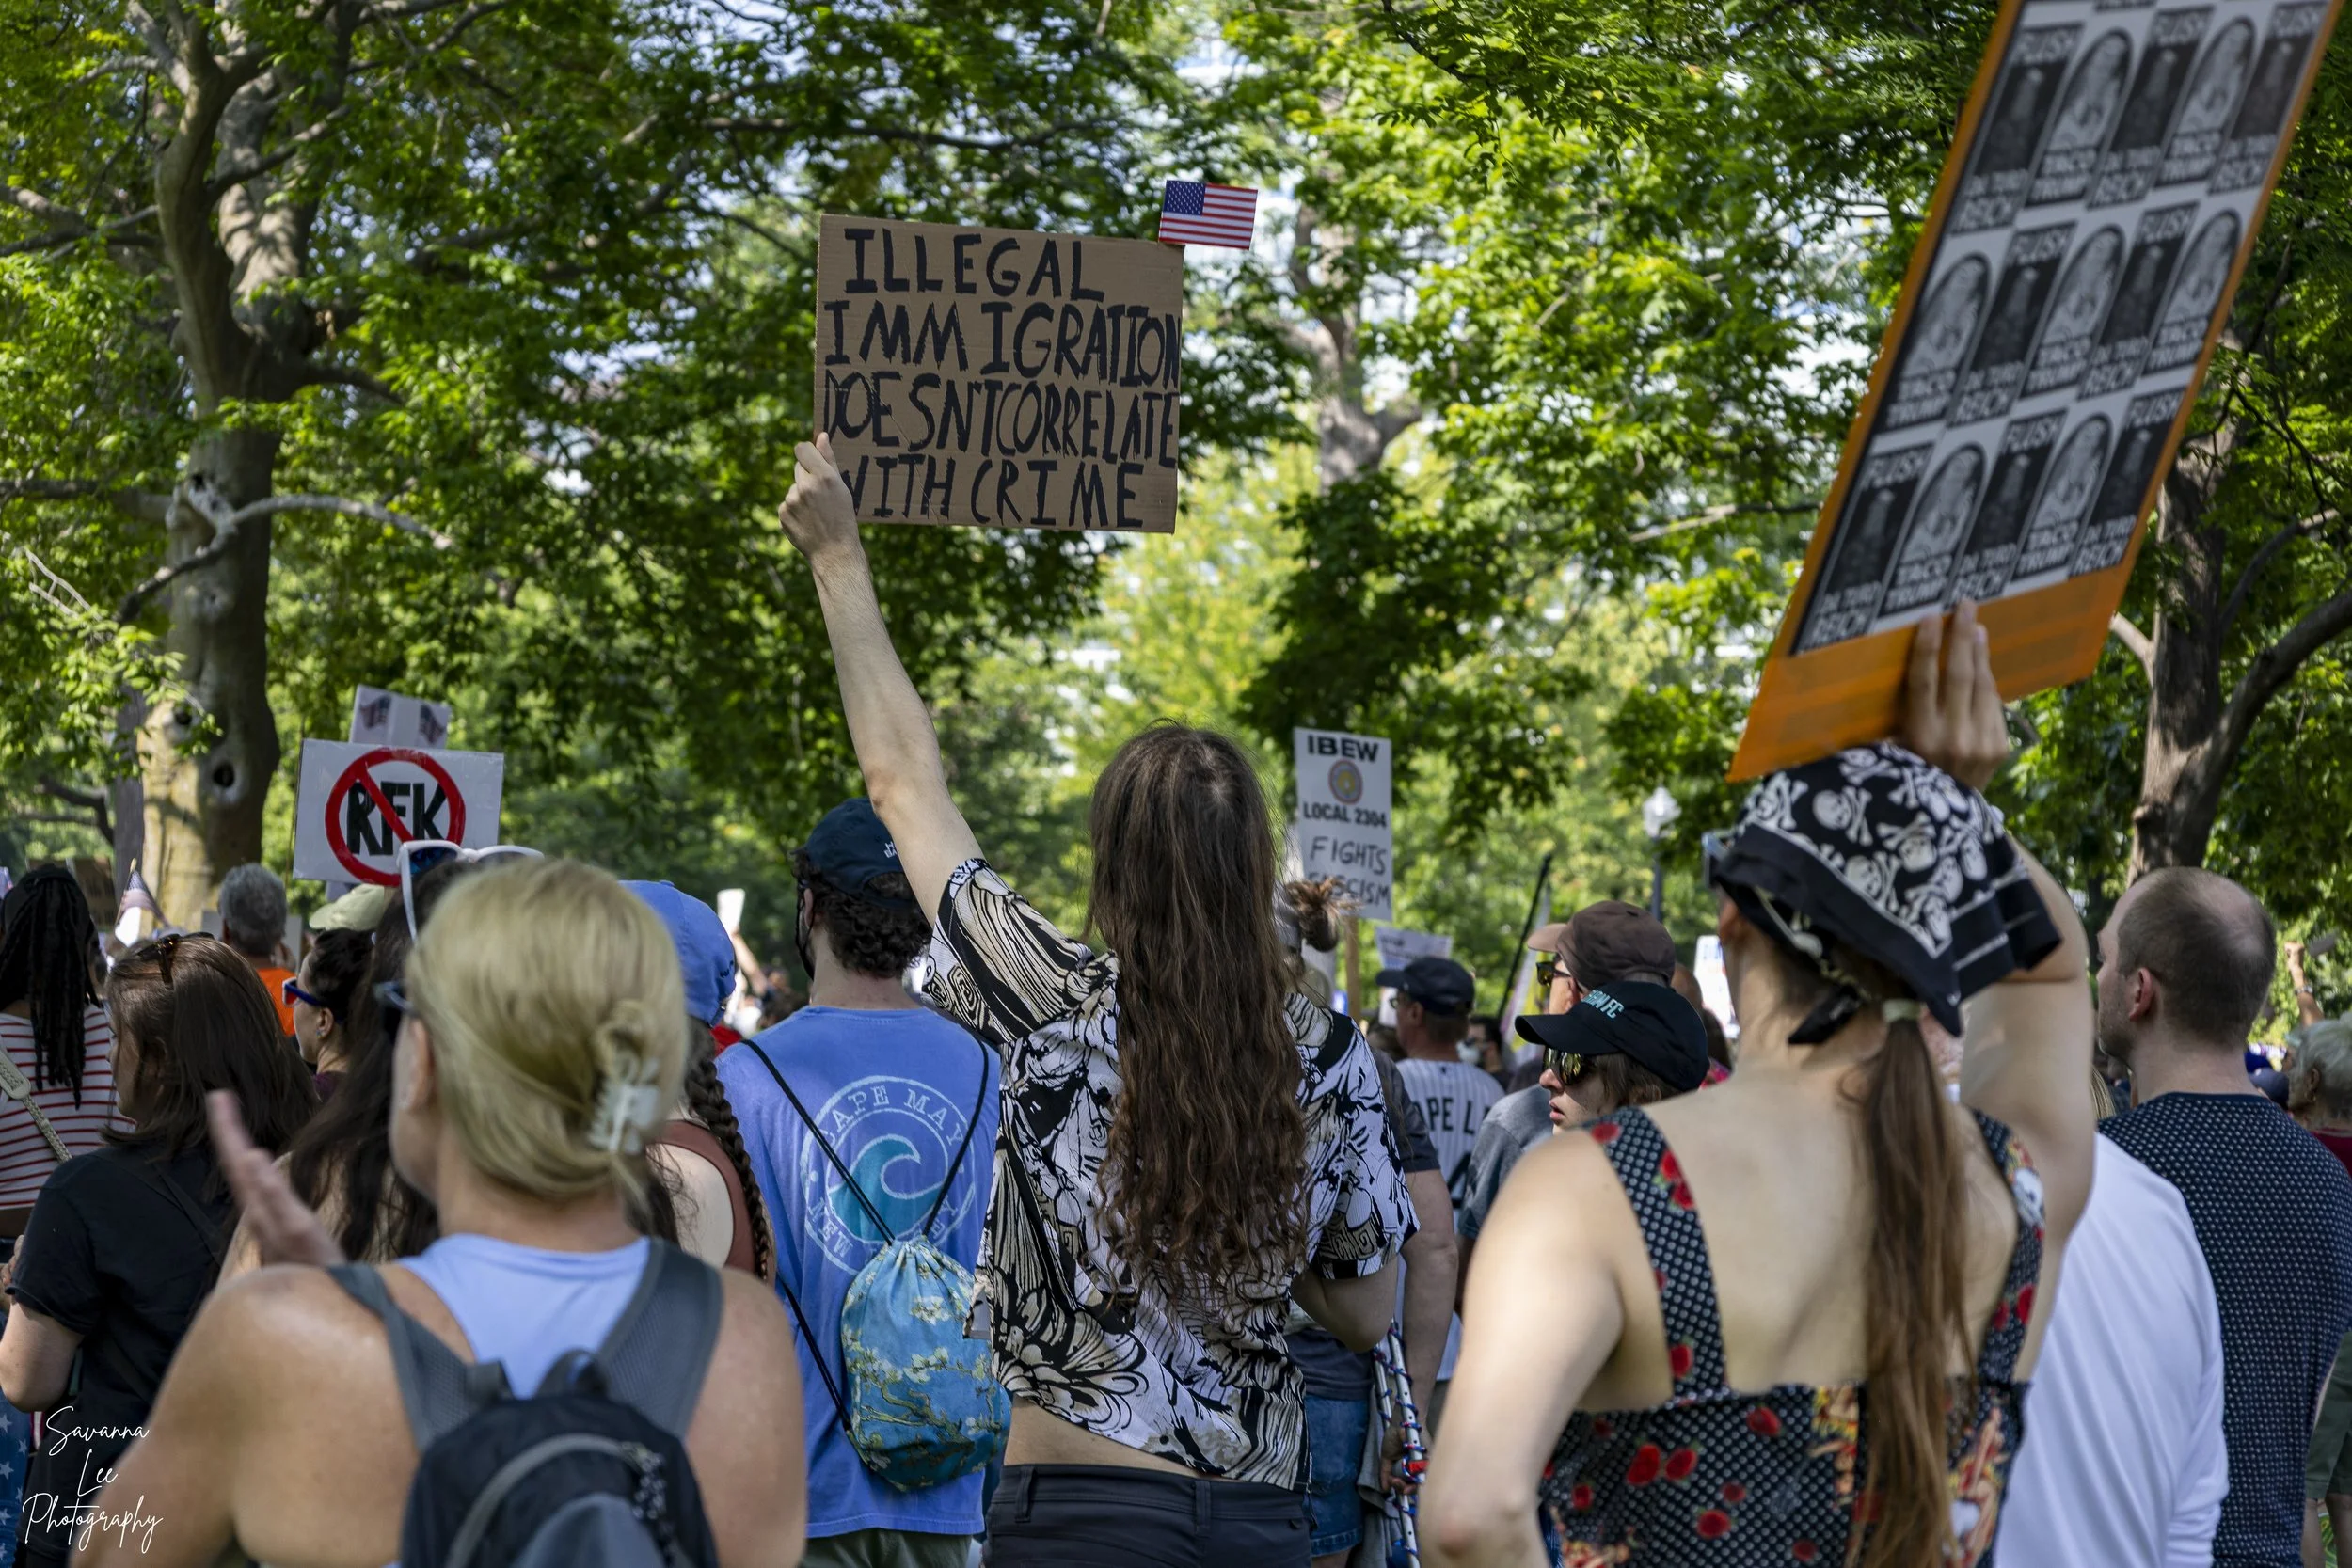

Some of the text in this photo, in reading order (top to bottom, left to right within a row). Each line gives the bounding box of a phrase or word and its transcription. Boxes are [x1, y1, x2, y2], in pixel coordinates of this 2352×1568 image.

[844, 228, 1104, 302] ILLEGAL
[824, 300, 1181, 388] IMMIGRATION
[971, 458, 1144, 530] CRIME
[1307, 735, 1379, 763] IBEW
[346, 780, 448, 856] RFK
[1302, 801, 1351, 823] LOCAL
[1310, 835, 1388, 877] FIGHTS
[1308, 871, 1391, 911] SCISM
[1599, 998, 1625, 1019] FC
[904, 1088, 965, 1147] MAY
